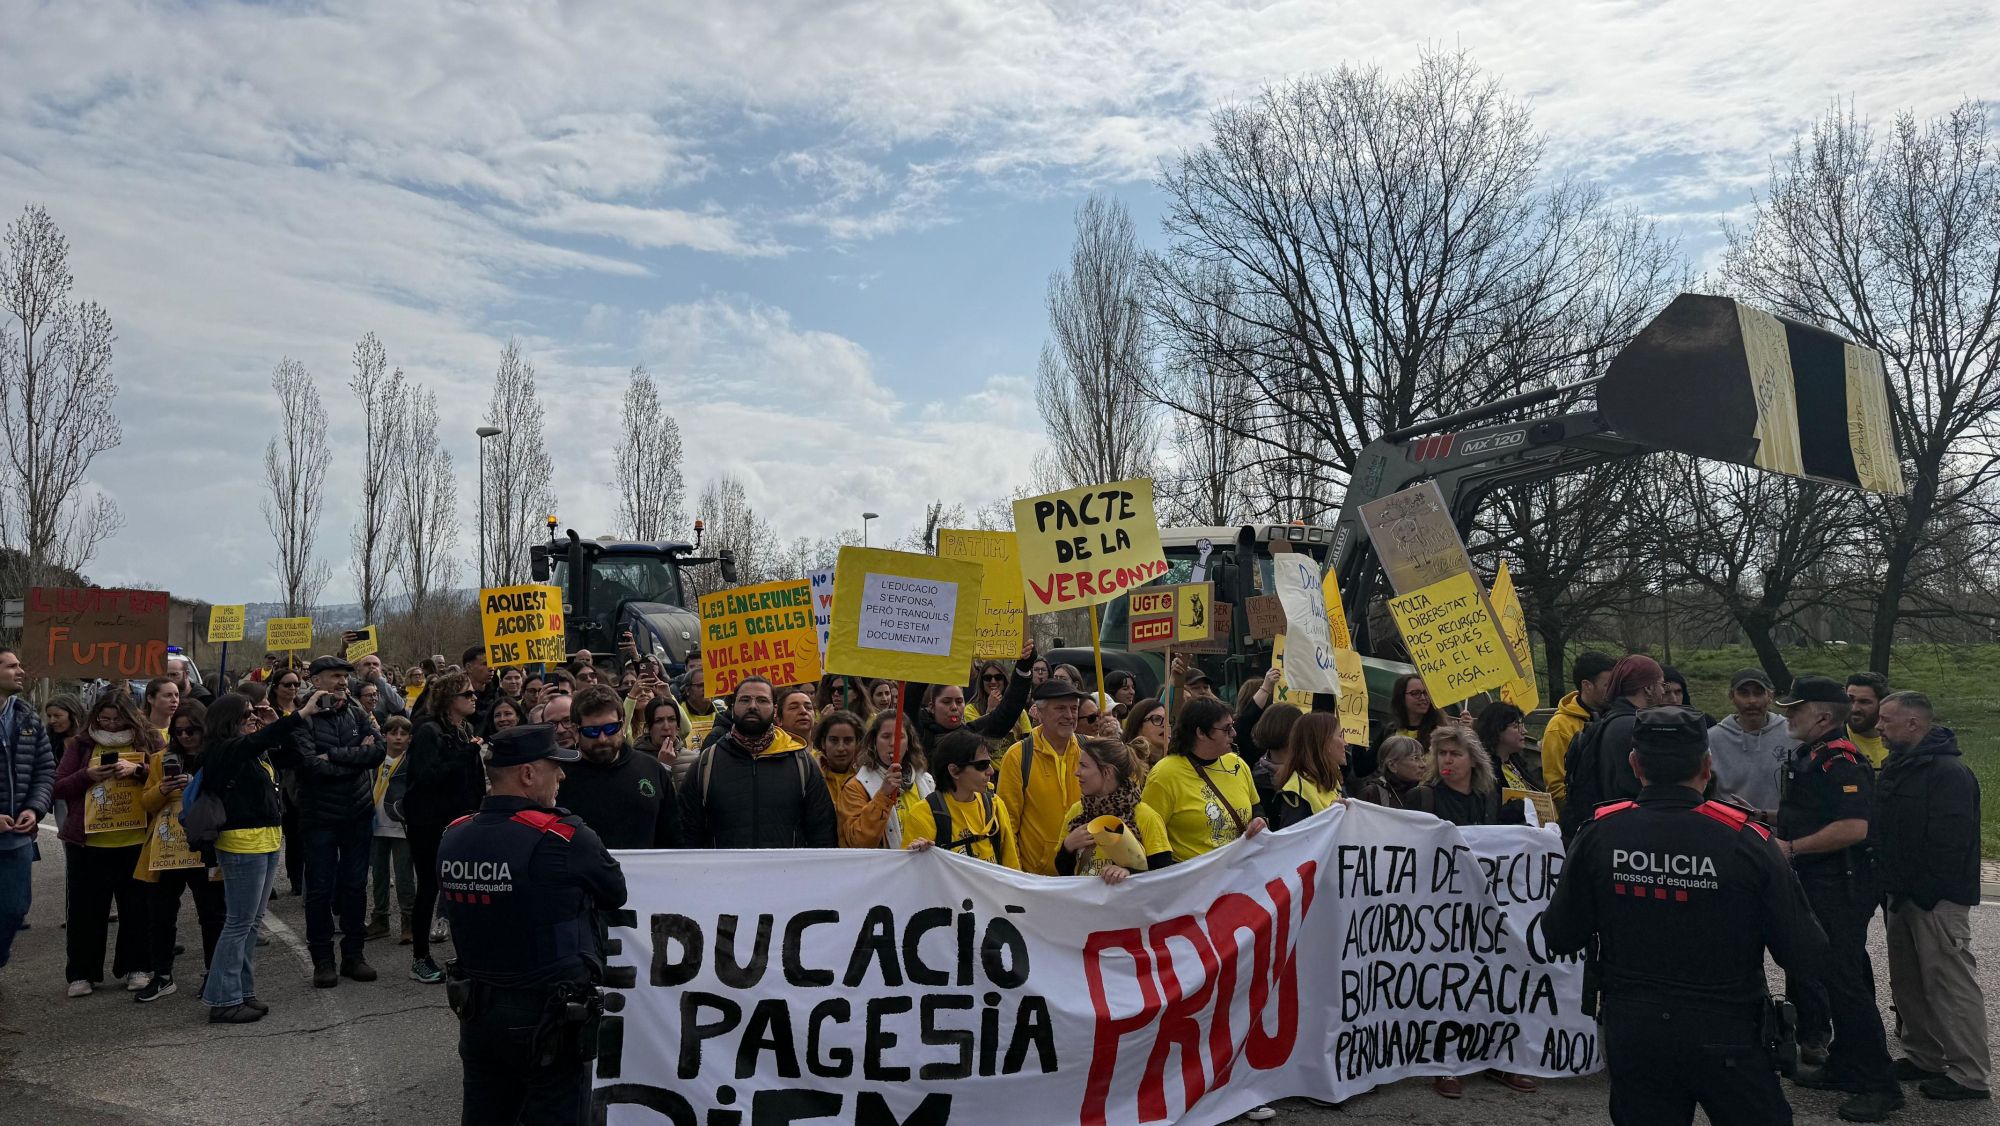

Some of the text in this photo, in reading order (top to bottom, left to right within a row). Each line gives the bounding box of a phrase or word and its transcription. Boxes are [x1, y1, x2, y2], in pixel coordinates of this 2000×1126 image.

[1464, 433, 1522, 453] MX 120
[1034, 490, 1136, 533] PACTE
[946, 535, 1009, 562] PATIM,
[1055, 528, 1131, 564] DE LA
[812, 574, 826, 587] NO
[881, 580, 938, 595] L'EDUCACIÓ
[1027, 560, 1168, 605] VERGONYA
[486, 591, 547, 615] AQUEST
[702, 585, 811, 620] LES ENGRUNES
[879, 593, 936, 608] S'ENFONSA,
[1132, 594, 1160, 612] UGT
[1391, 594, 1432, 617] MOLTA
[1473, 591, 1480, 605] Y
[866, 603, 950, 624] PERÒ TRANQUILS,
[495, 613, 561, 637] ACORD NO
[709, 609, 814, 641] PELS OCELLS!
[880, 619, 930, 632] HO ESTEM
[975, 622, 1020, 637] nostres
[1134, 621, 1170, 639] CCOO
[866, 630, 940, 645] DOCUMENTANT
[1407, 630, 1433, 647] POCS
[1436, 627, 1482, 653] DESPUÉS
[48, 626, 168, 676] FUTUR
[490, 642, 520, 664] ENS
[706, 639, 795, 670] VOLEM EL
[1420, 641, 1493, 676] PAÇA EL KE
[1447, 665, 1499, 689] PASA...
[88, 819, 141, 831] ESCOLA MIGDIA
[152, 859, 176, 868] ESCOLA
[441, 859, 512, 881] POLICIA
[1338, 844, 1417, 899] FALTA
[1431, 845, 1470, 894] DE
[1612, 849, 1717, 877] POLICIA
[442, 881, 513, 893] mossos d'esquadra
[1613, 872, 1718, 890] mossos d'esquadra
